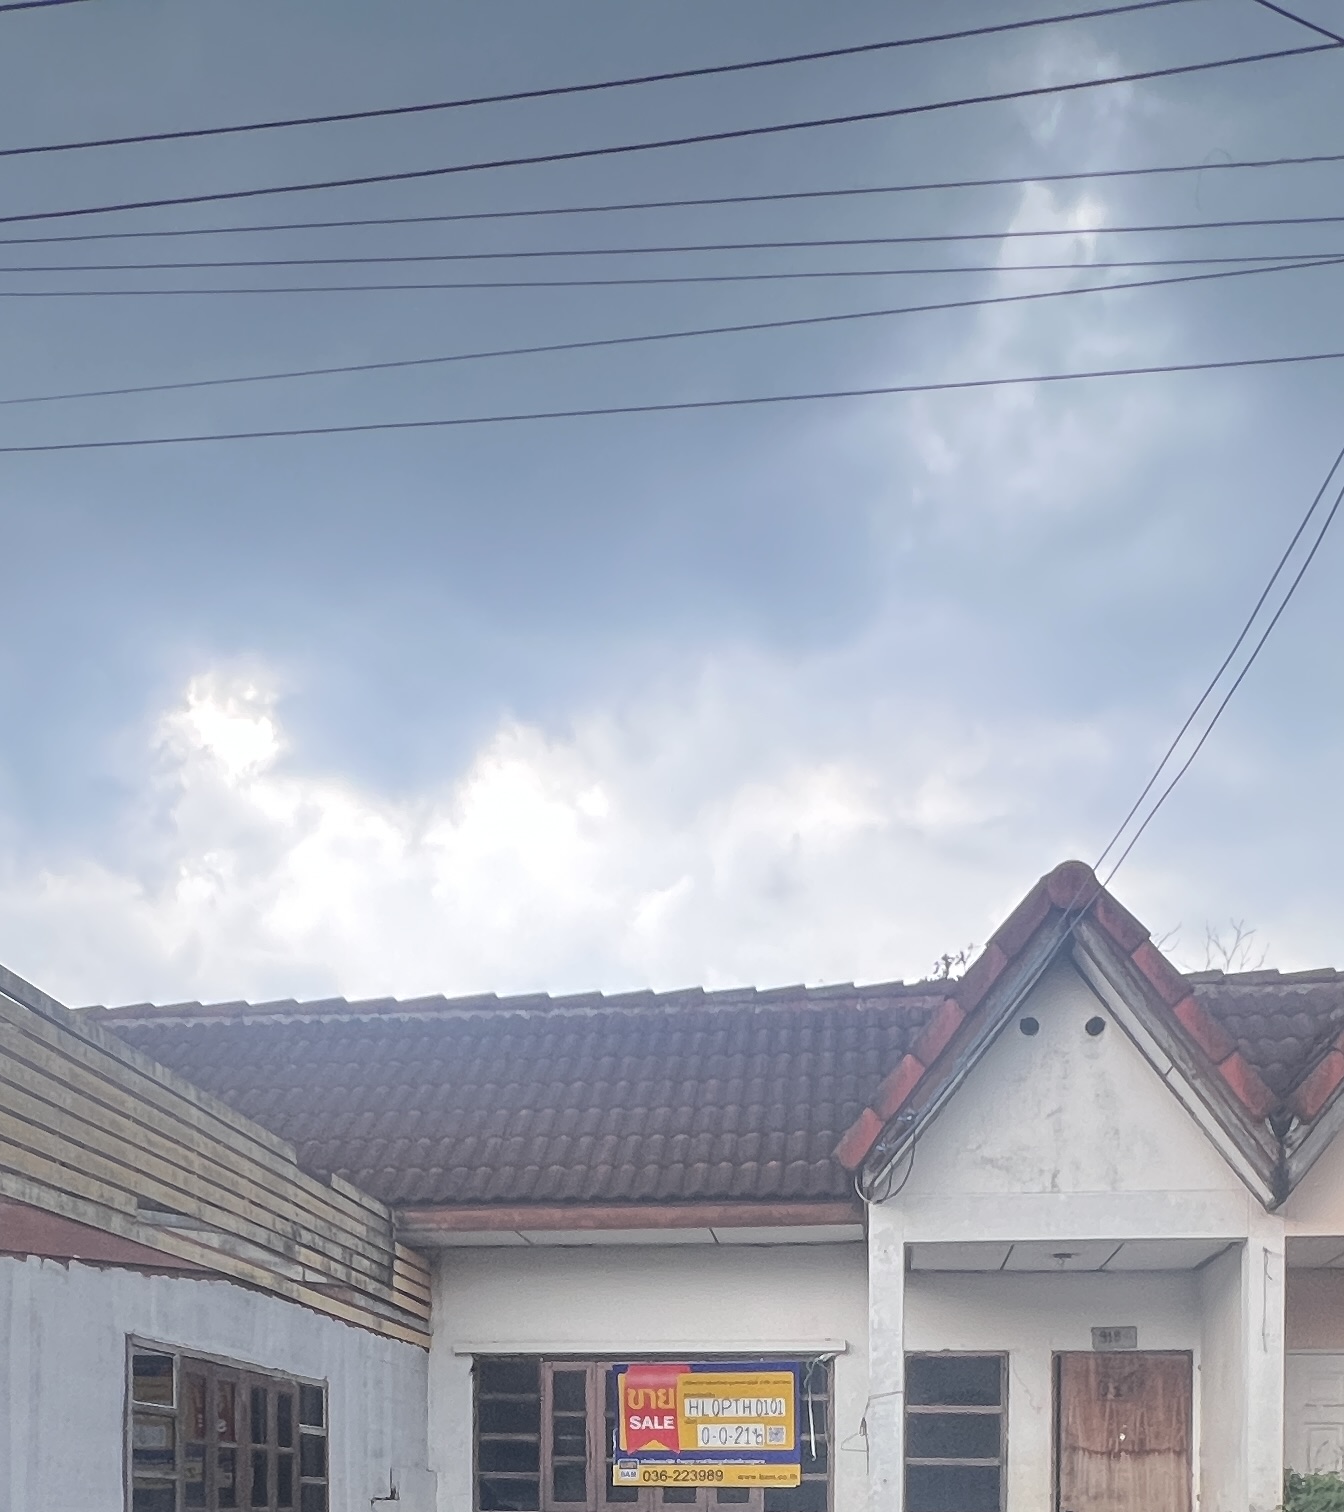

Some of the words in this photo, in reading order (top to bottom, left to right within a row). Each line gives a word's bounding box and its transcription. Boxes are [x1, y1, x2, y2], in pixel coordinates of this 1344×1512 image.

[627, 1387, 675, 1410] ขาย
[629, 1415, 676, 1430] SALE
[642, 1469, 724, 1482] 036-223989
